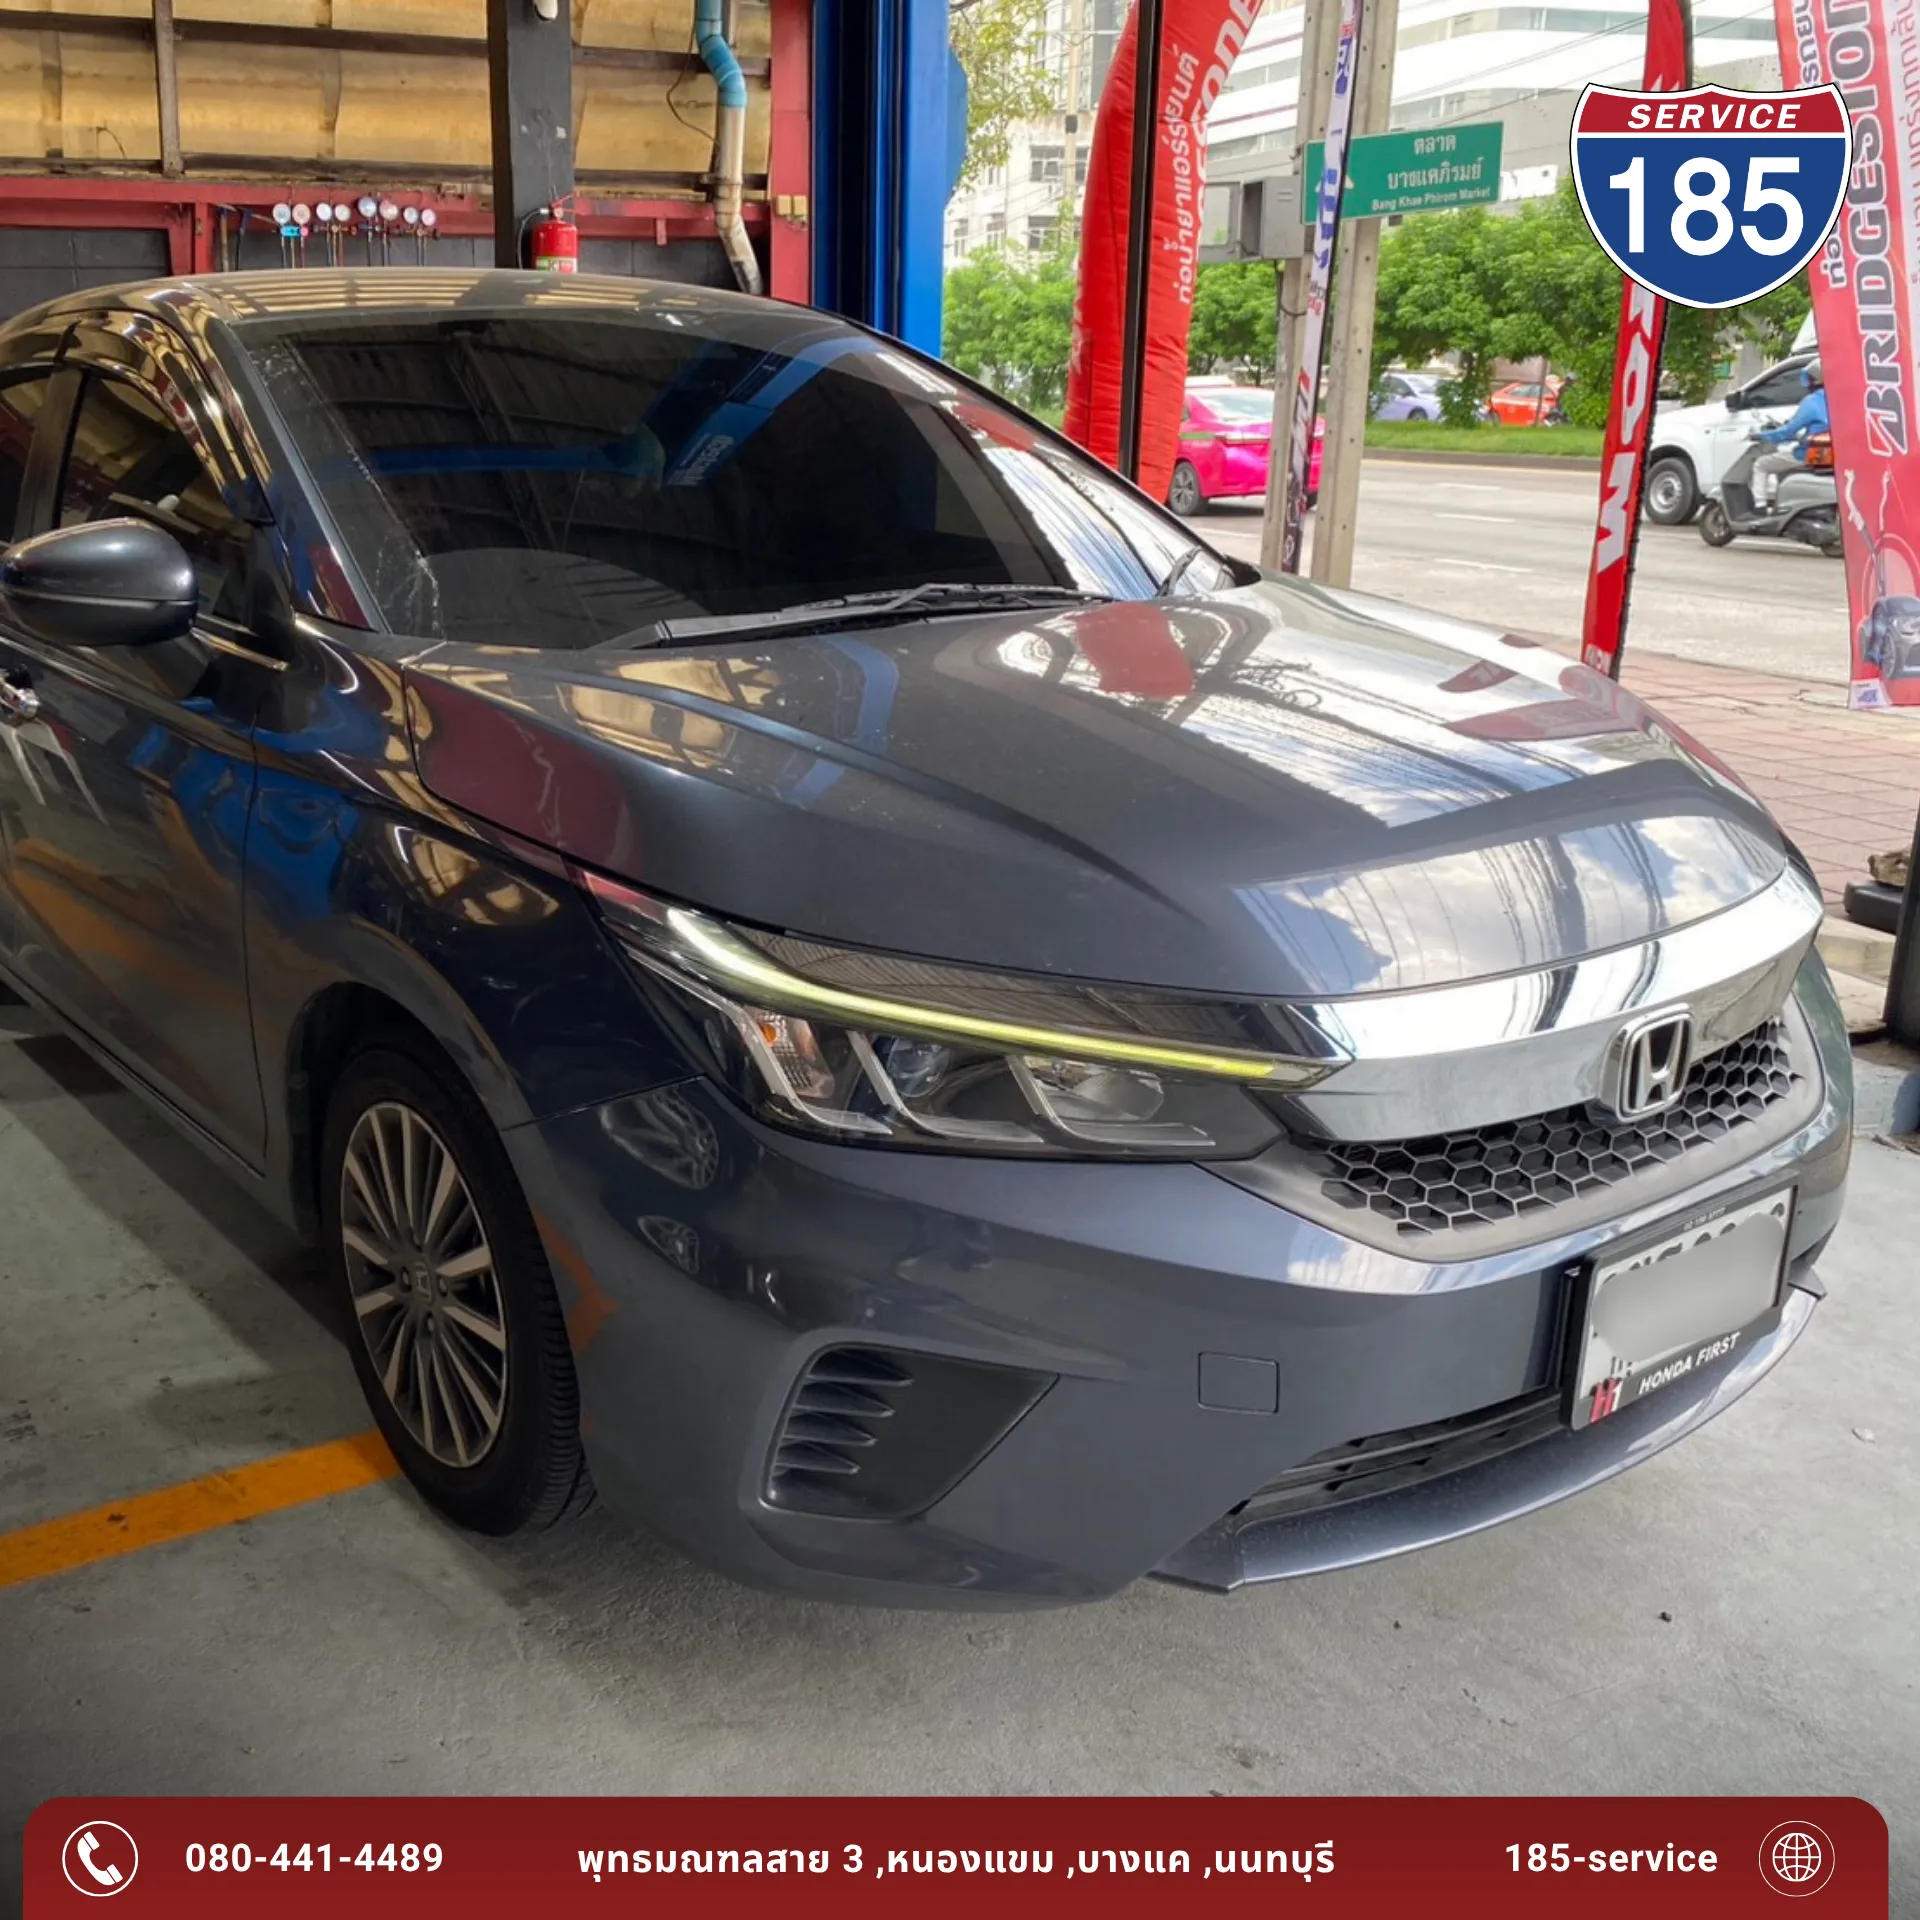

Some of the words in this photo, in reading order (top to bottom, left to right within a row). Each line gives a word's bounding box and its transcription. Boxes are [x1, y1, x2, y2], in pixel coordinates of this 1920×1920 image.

[1413, 135, 1457, 155] ตลาด
[1387, 156, 1484, 190] บางแคภิรมย์
[1372, 199, 1397, 211] Bang
[1638, 1355, 1692, 1395] HONDA
[1696, 1332, 1741, 1366] FIRST
